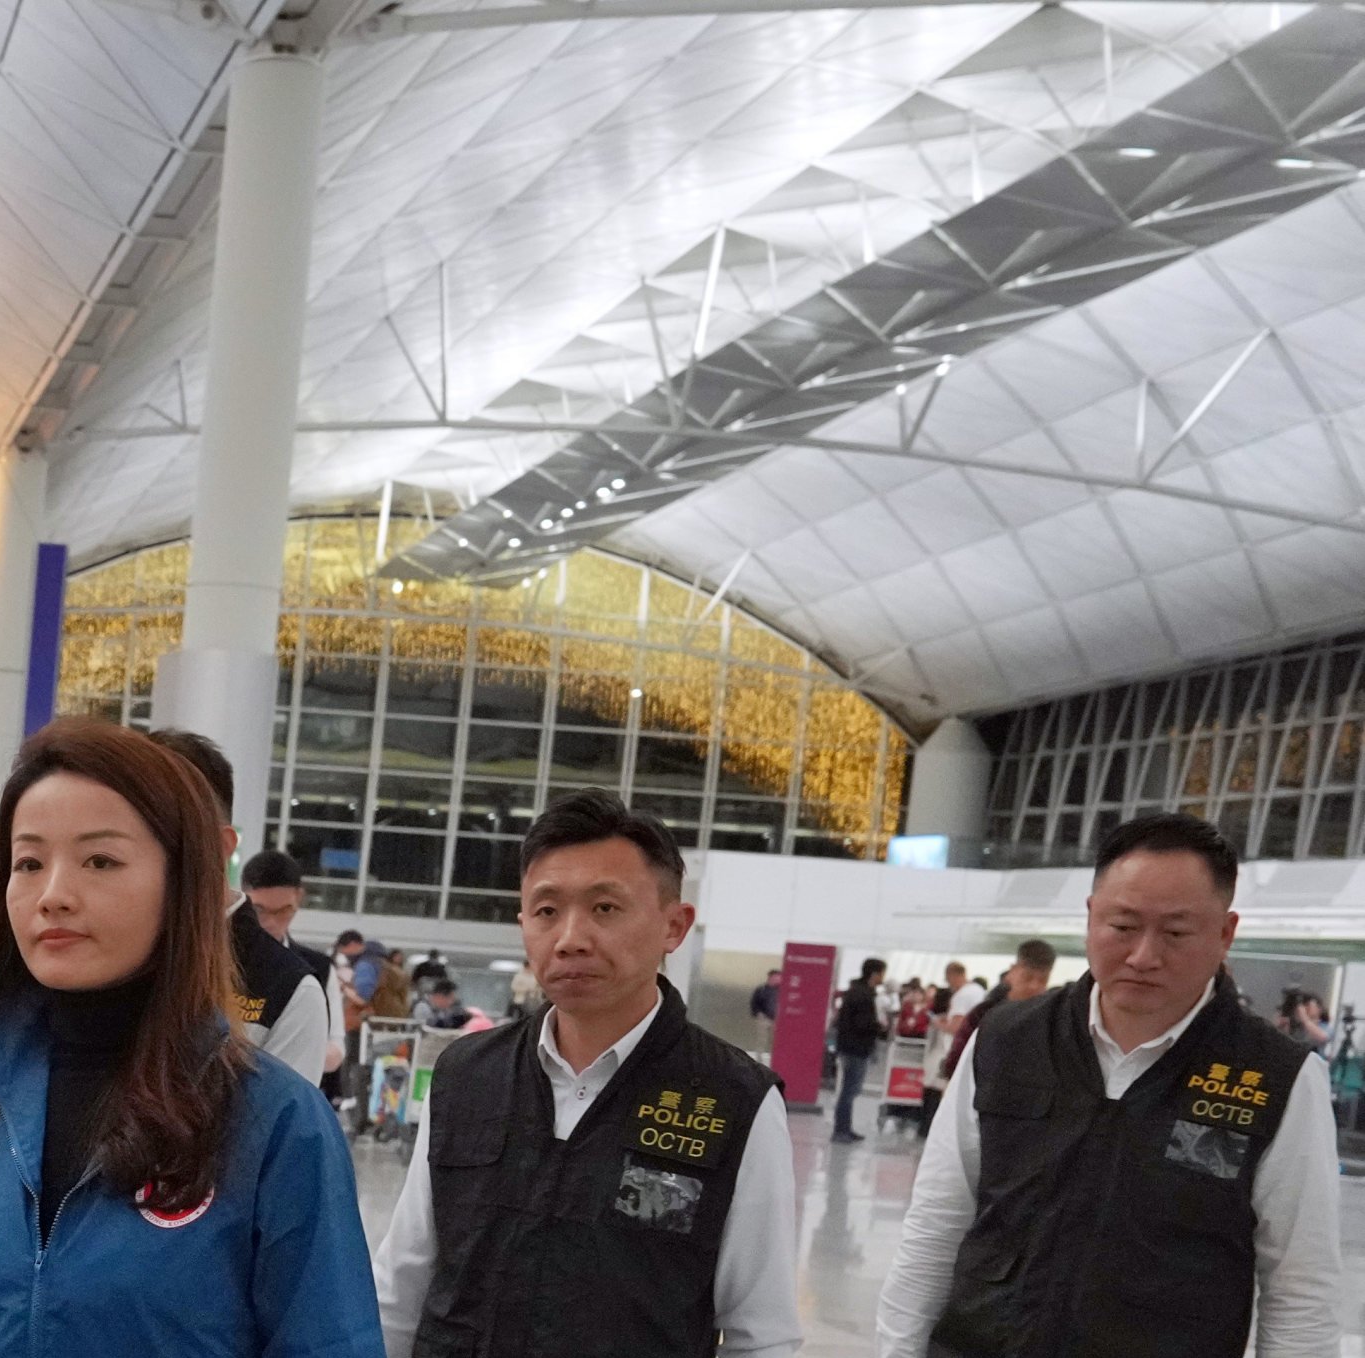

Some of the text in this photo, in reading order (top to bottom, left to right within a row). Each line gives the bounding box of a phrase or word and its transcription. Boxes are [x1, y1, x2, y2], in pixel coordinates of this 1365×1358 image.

[659, 1090, 716, 1114] 警察
[1188, 1075, 1269, 1106] POLICE
[638, 1104, 726, 1134] POLICE
[1192, 1100, 1254, 1125] OCTB
[640, 1127, 705, 1157] OCTB
[168, 1217, 191, 1227] KONG
